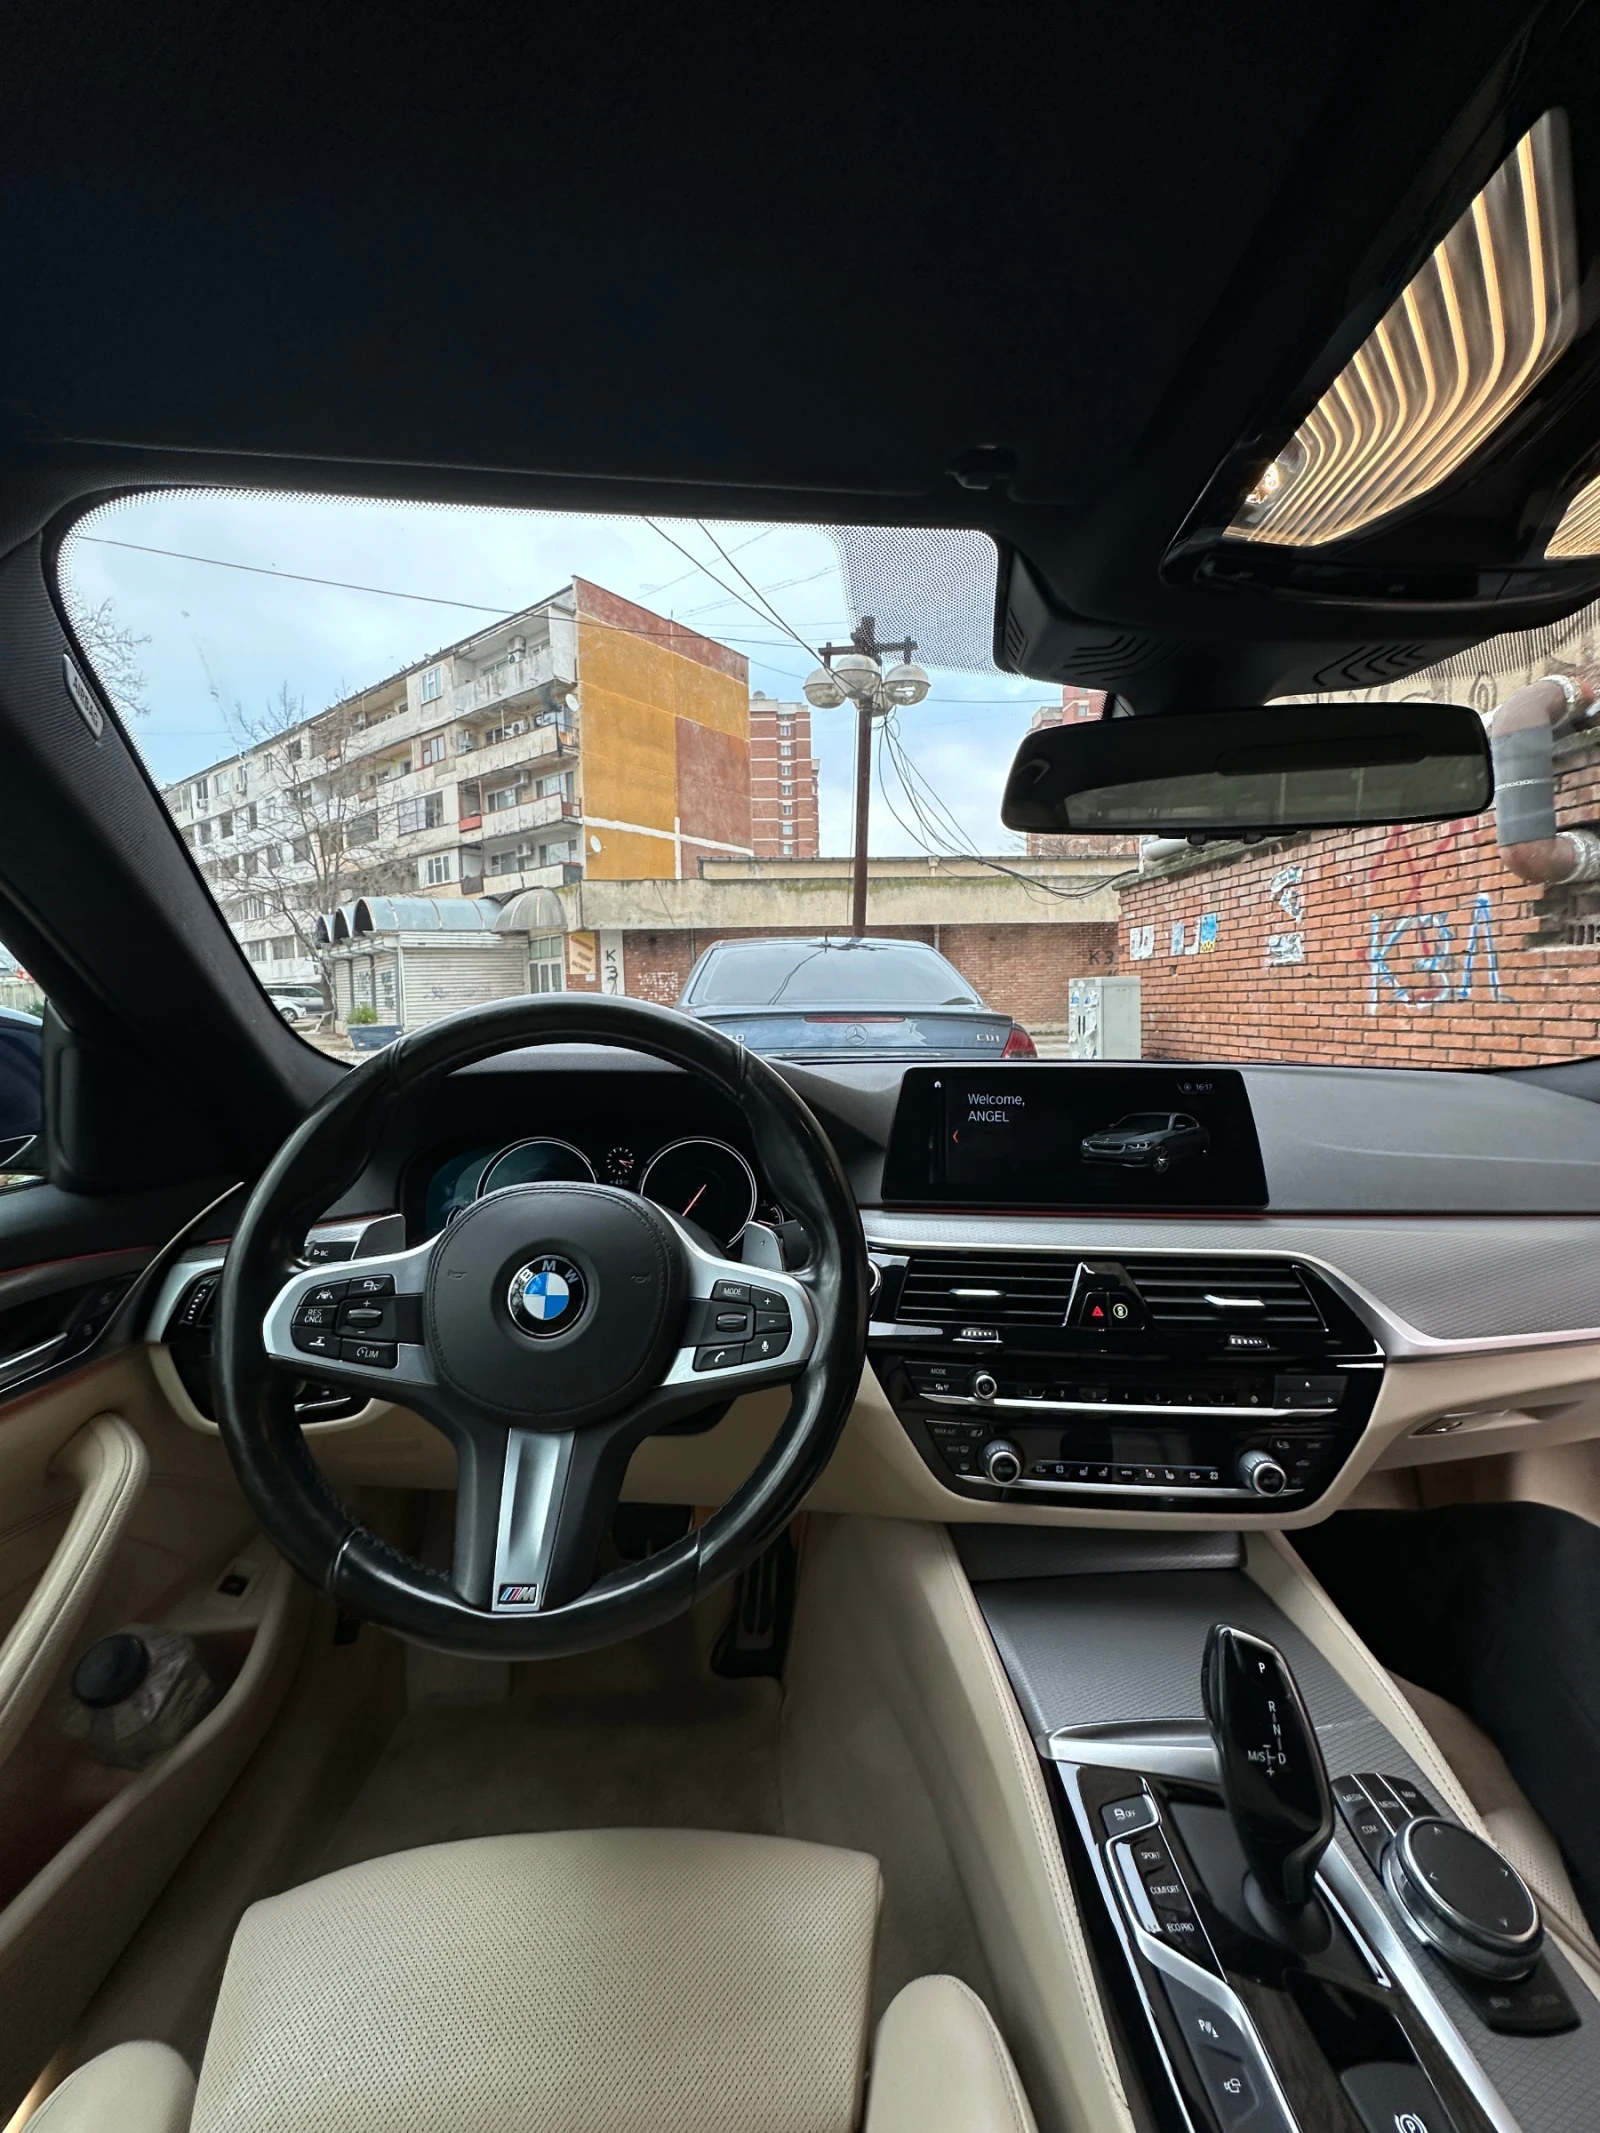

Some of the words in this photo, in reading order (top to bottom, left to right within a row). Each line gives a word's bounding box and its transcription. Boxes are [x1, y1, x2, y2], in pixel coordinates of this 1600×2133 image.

[73, 676, 98, 727] AIRBAG
[976, 1034, 1000, 1043] CDI
[967, 1093, 1025, 1107] Welcome,
[968, 1110, 1010, 1122] ANGEL
[519, 1259, 580, 1284] BMW
[723, 1287, 742, 1296] MODE
[307, 1308, 322, 1316] RES
[304, 1315, 324, 1324] CNCL
[364, 1350, 380, 1359] LIM
[1060, 1389, 1065, 1398] 2
[1258, 1662, 1265, 1673] P
[1268, 1701, 1276, 1712] R
[1273, 1724, 1281, 1736] N
[1248, 1750, 1266, 1761] M/S
[1278, 1753, 1286, 1764] D
[1125, 1810, 1136, 1818] OFF
[1141, 1851, 1161, 1860] SPORT
[1150, 1884, 1180, 1895] COMFORT
[1167, 1924, 1181, 1932] ECO
[1181, 1923, 1194, 1932] PRO
